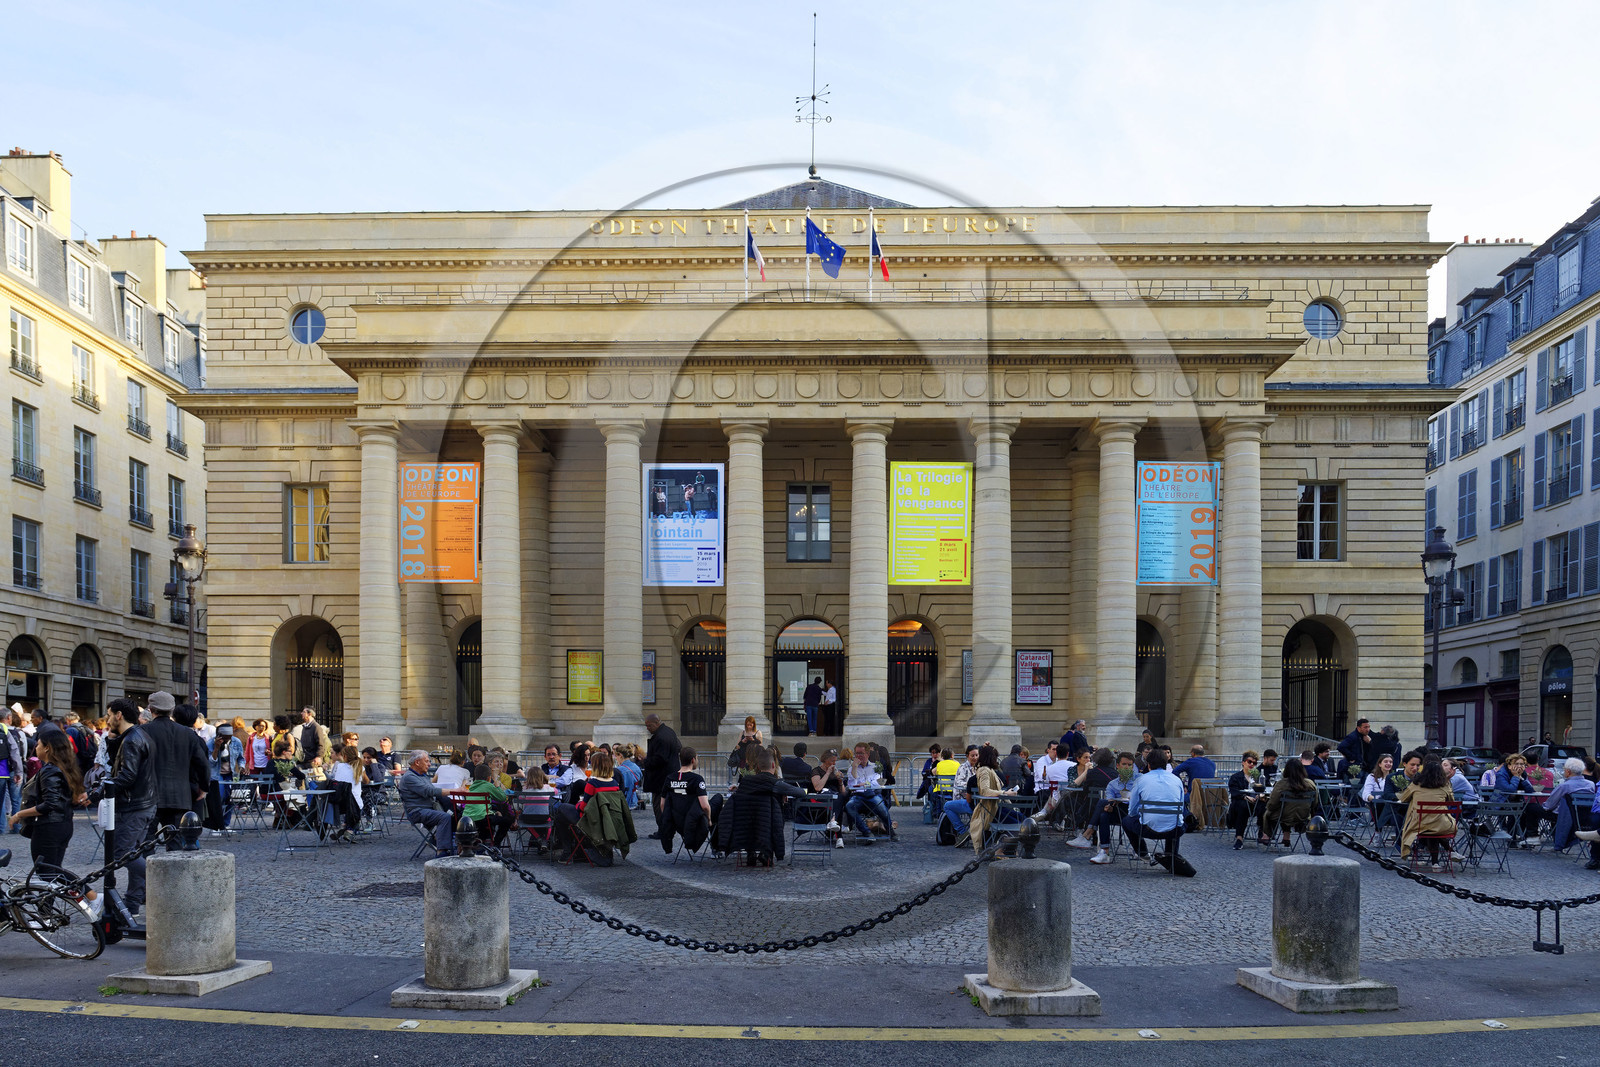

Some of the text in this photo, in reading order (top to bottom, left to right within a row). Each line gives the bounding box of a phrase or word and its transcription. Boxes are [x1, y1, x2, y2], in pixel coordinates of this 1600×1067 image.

[590, 218, 687, 234] ODEON
[852, 218, 886, 233] DE
[903, 216, 1036, 233] L'EUROPE
[898, 471, 963, 485] La Trilogie
[1143, 466, 1213, 482] ODÉON
[898, 485, 930, 496] de la
[898, 500, 964, 510] vengeance
[650, 512, 706, 526] Le Pays
[650, 526, 702, 537] lointain
[402, 506, 425, 576] 2018
[1189, 507, 1214, 579] 2019
